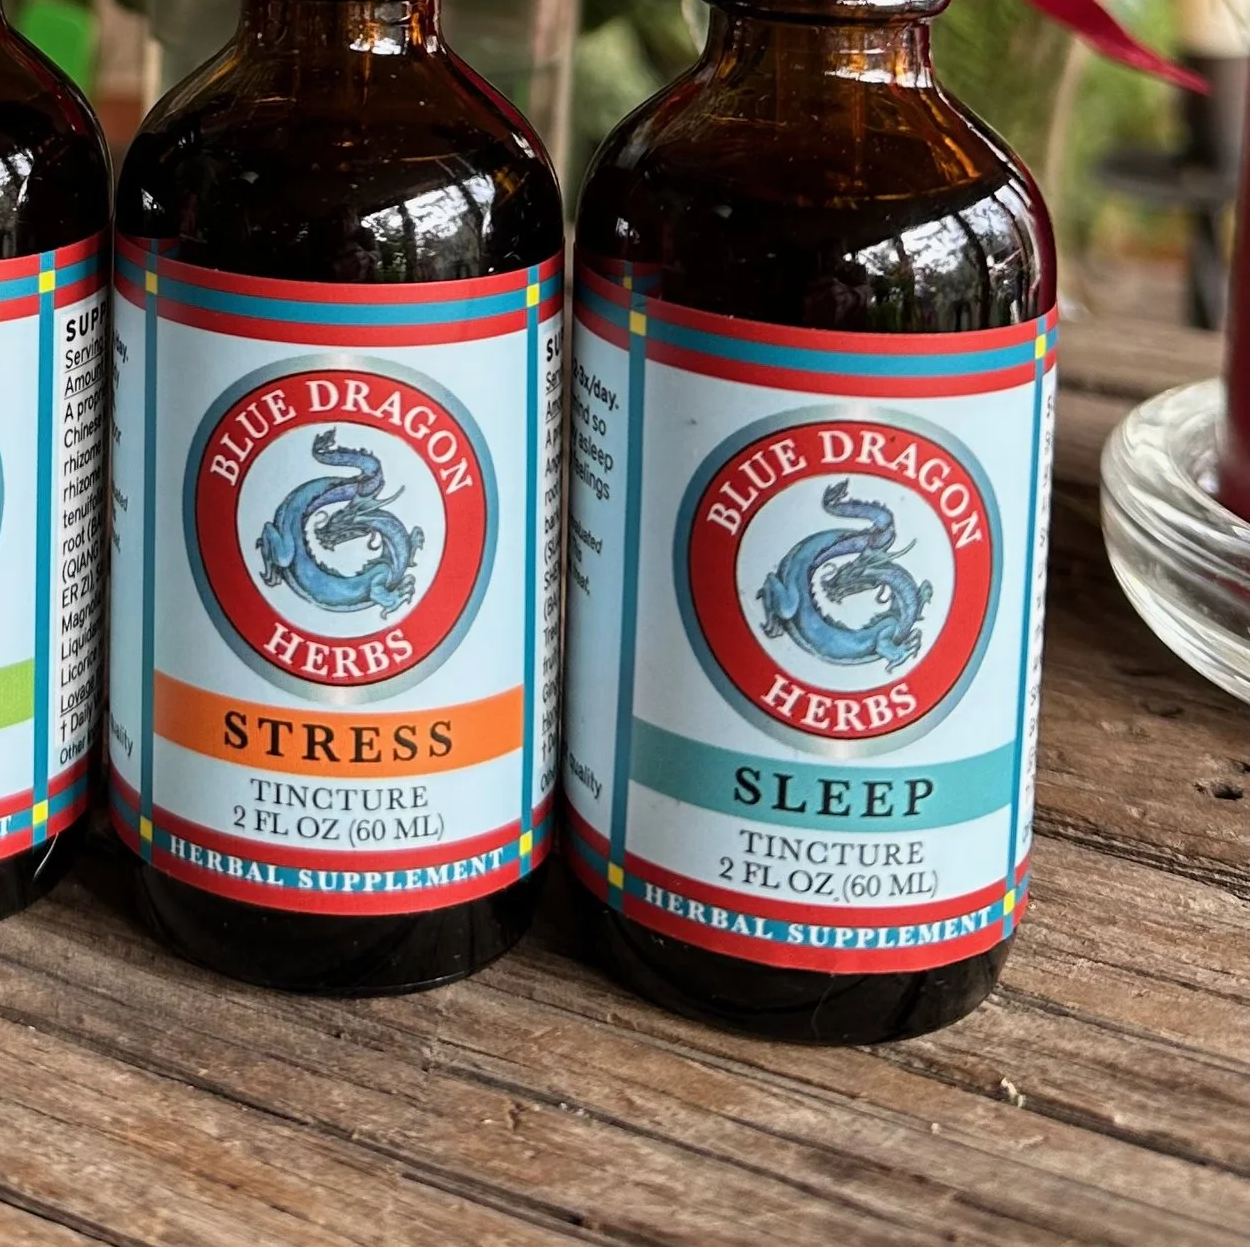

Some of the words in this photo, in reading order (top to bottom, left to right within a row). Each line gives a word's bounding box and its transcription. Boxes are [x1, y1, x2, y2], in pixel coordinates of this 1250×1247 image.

[210, 387, 298, 488] BLUE
[307, 378, 475, 497] DRAGON
[592, 413, 608, 437] so
[578, 431, 615, 475] asleep
[705, 438, 808, 537] BLUE
[818, 429, 985, 552] DRAGON
[262, 622, 417, 679] HERBS
[760, 673, 918, 733] HERBS
[222, 710, 455, 764] STRESS
[250, 776, 430, 812] TINCTURE
[732, 765, 936, 819] SLEEP
[232, 803, 247, 830] 2
[253, 808, 290, 838] FL
[296, 813, 341, 842] OZ
[347, 814, 387, 847] (60
[395, 812, 446, 843] ML)
[738, 829, 925, 866] TINCTURE
[168, 831, 286, 887] HERBAL
[298, 847, 506, 894] SUPPLEMENT
[718, 855, 735, 881] 2
[742, 861, 780, 890] FL
[788, 869, 834, 896] OZ
[841, 872, 882, 903] (60
[888, 869, 939, 899] ML)
[641, 883, 775, 941] HERBAL
[785, 908, 994, 950] SUPPLEMENT
